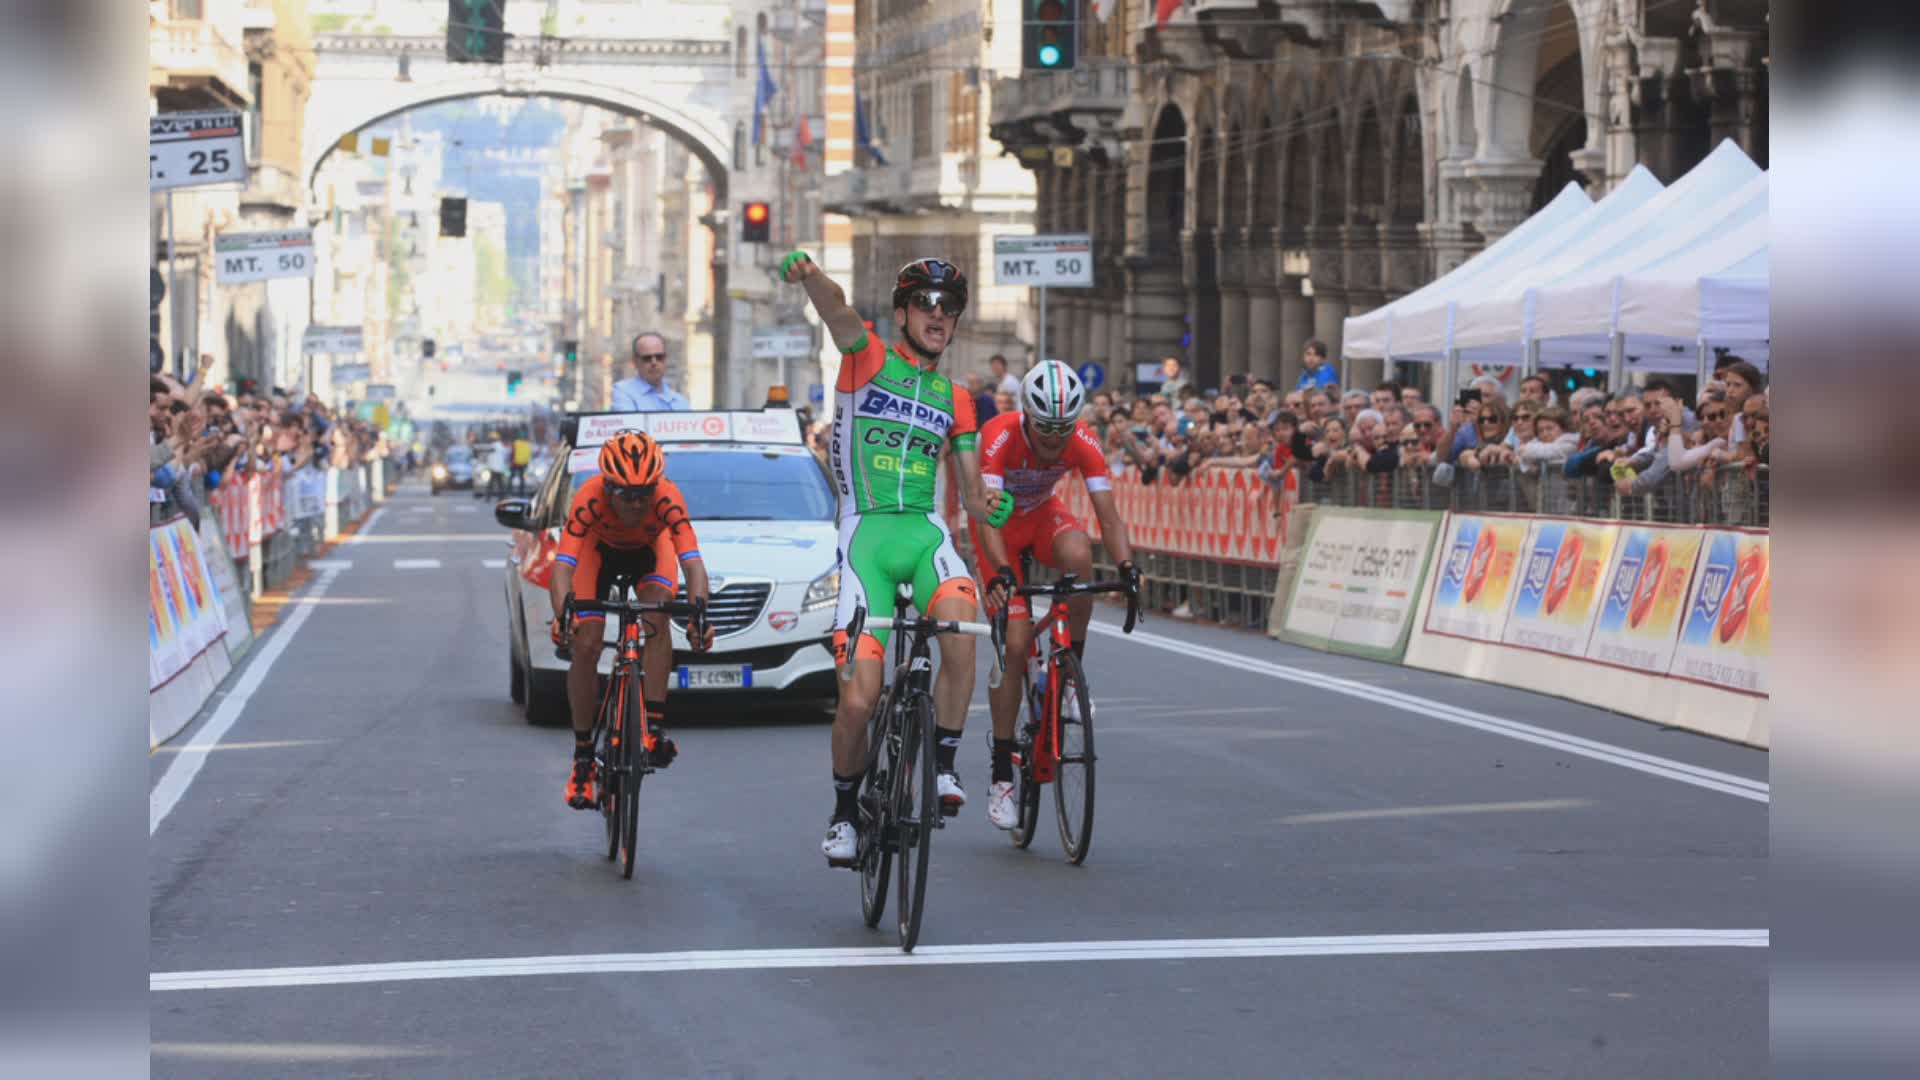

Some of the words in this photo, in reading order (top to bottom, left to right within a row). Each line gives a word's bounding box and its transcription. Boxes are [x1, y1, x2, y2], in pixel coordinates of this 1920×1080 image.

[188, 149, 230, 176] 25
[225, 258, 262, 274] MT.
[279, 254, 305, 272] 50
[1003, 260, 1040, 276] MT.
[1055, 258, 1082, 275] 50
[656, 418, 698, 433] JURY
[567, 498, 602, 538] CCC
[656, 496, 692, 535] CCC
